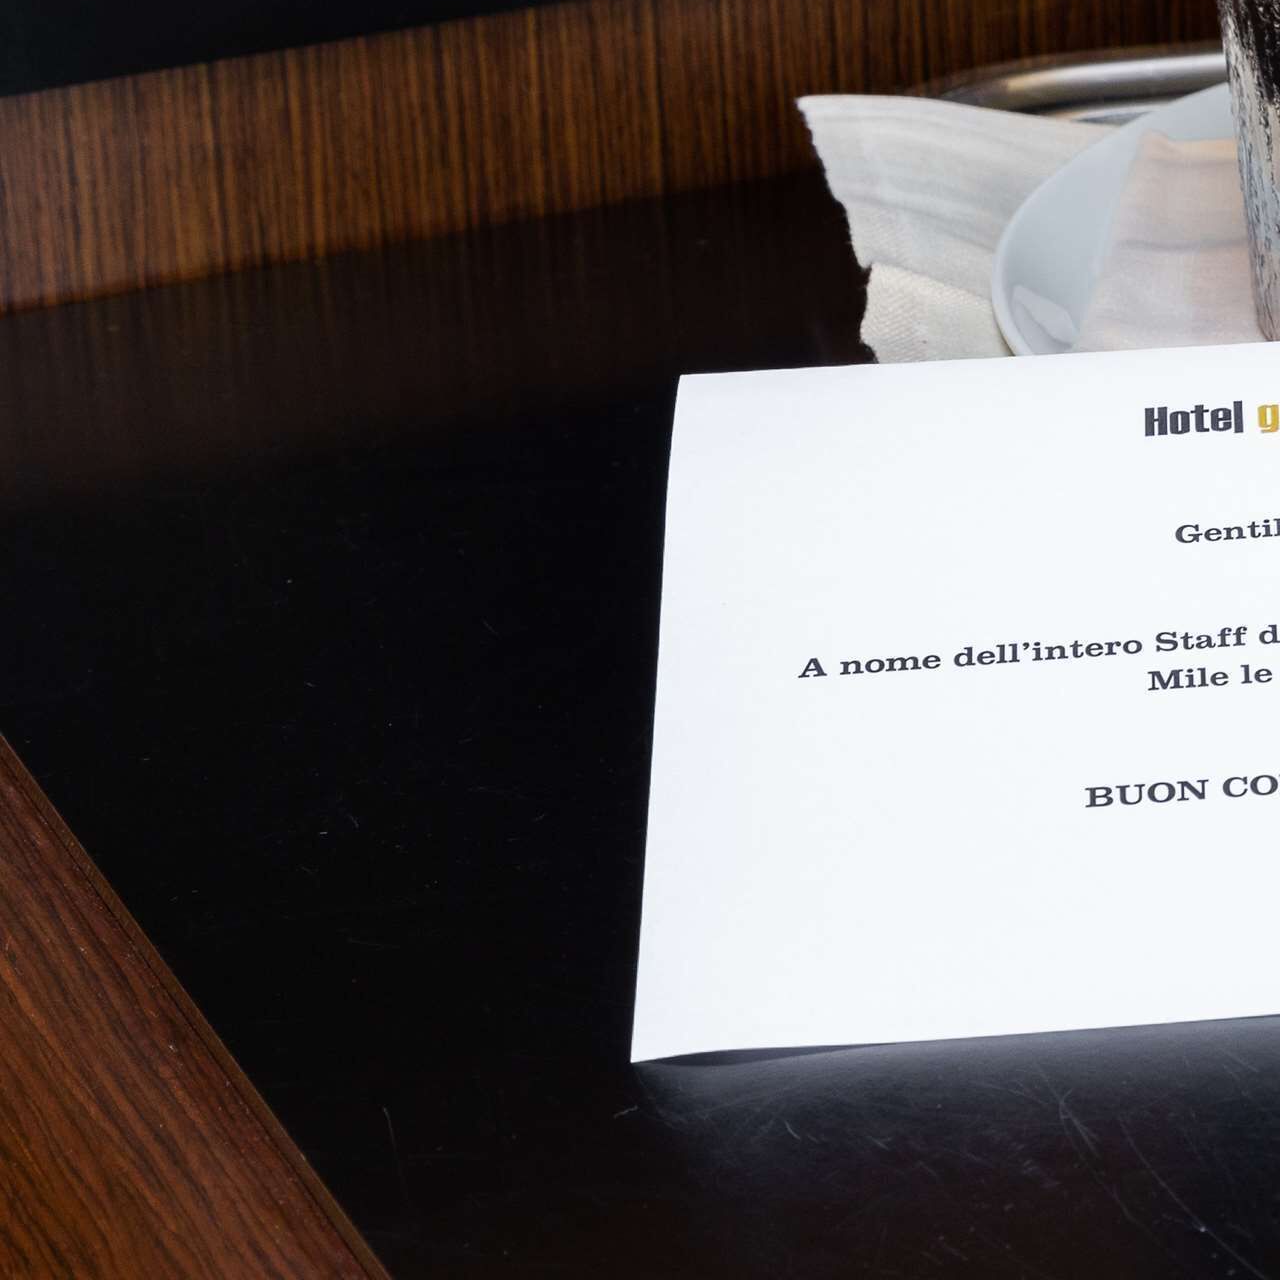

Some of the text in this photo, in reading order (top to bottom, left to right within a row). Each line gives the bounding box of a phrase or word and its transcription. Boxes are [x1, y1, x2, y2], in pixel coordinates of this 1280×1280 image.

[1144, 399, 1244, 437] Hotel
[797, 657, 828, 679] A
[839, 654, 942, 676] nome
[1155, 625, 1248, 653] Staff
[1147, 667, 1229, 692] Mile
[1240, 663, 1273, 685] le
[1084, 778, 1210, 808] BUON
